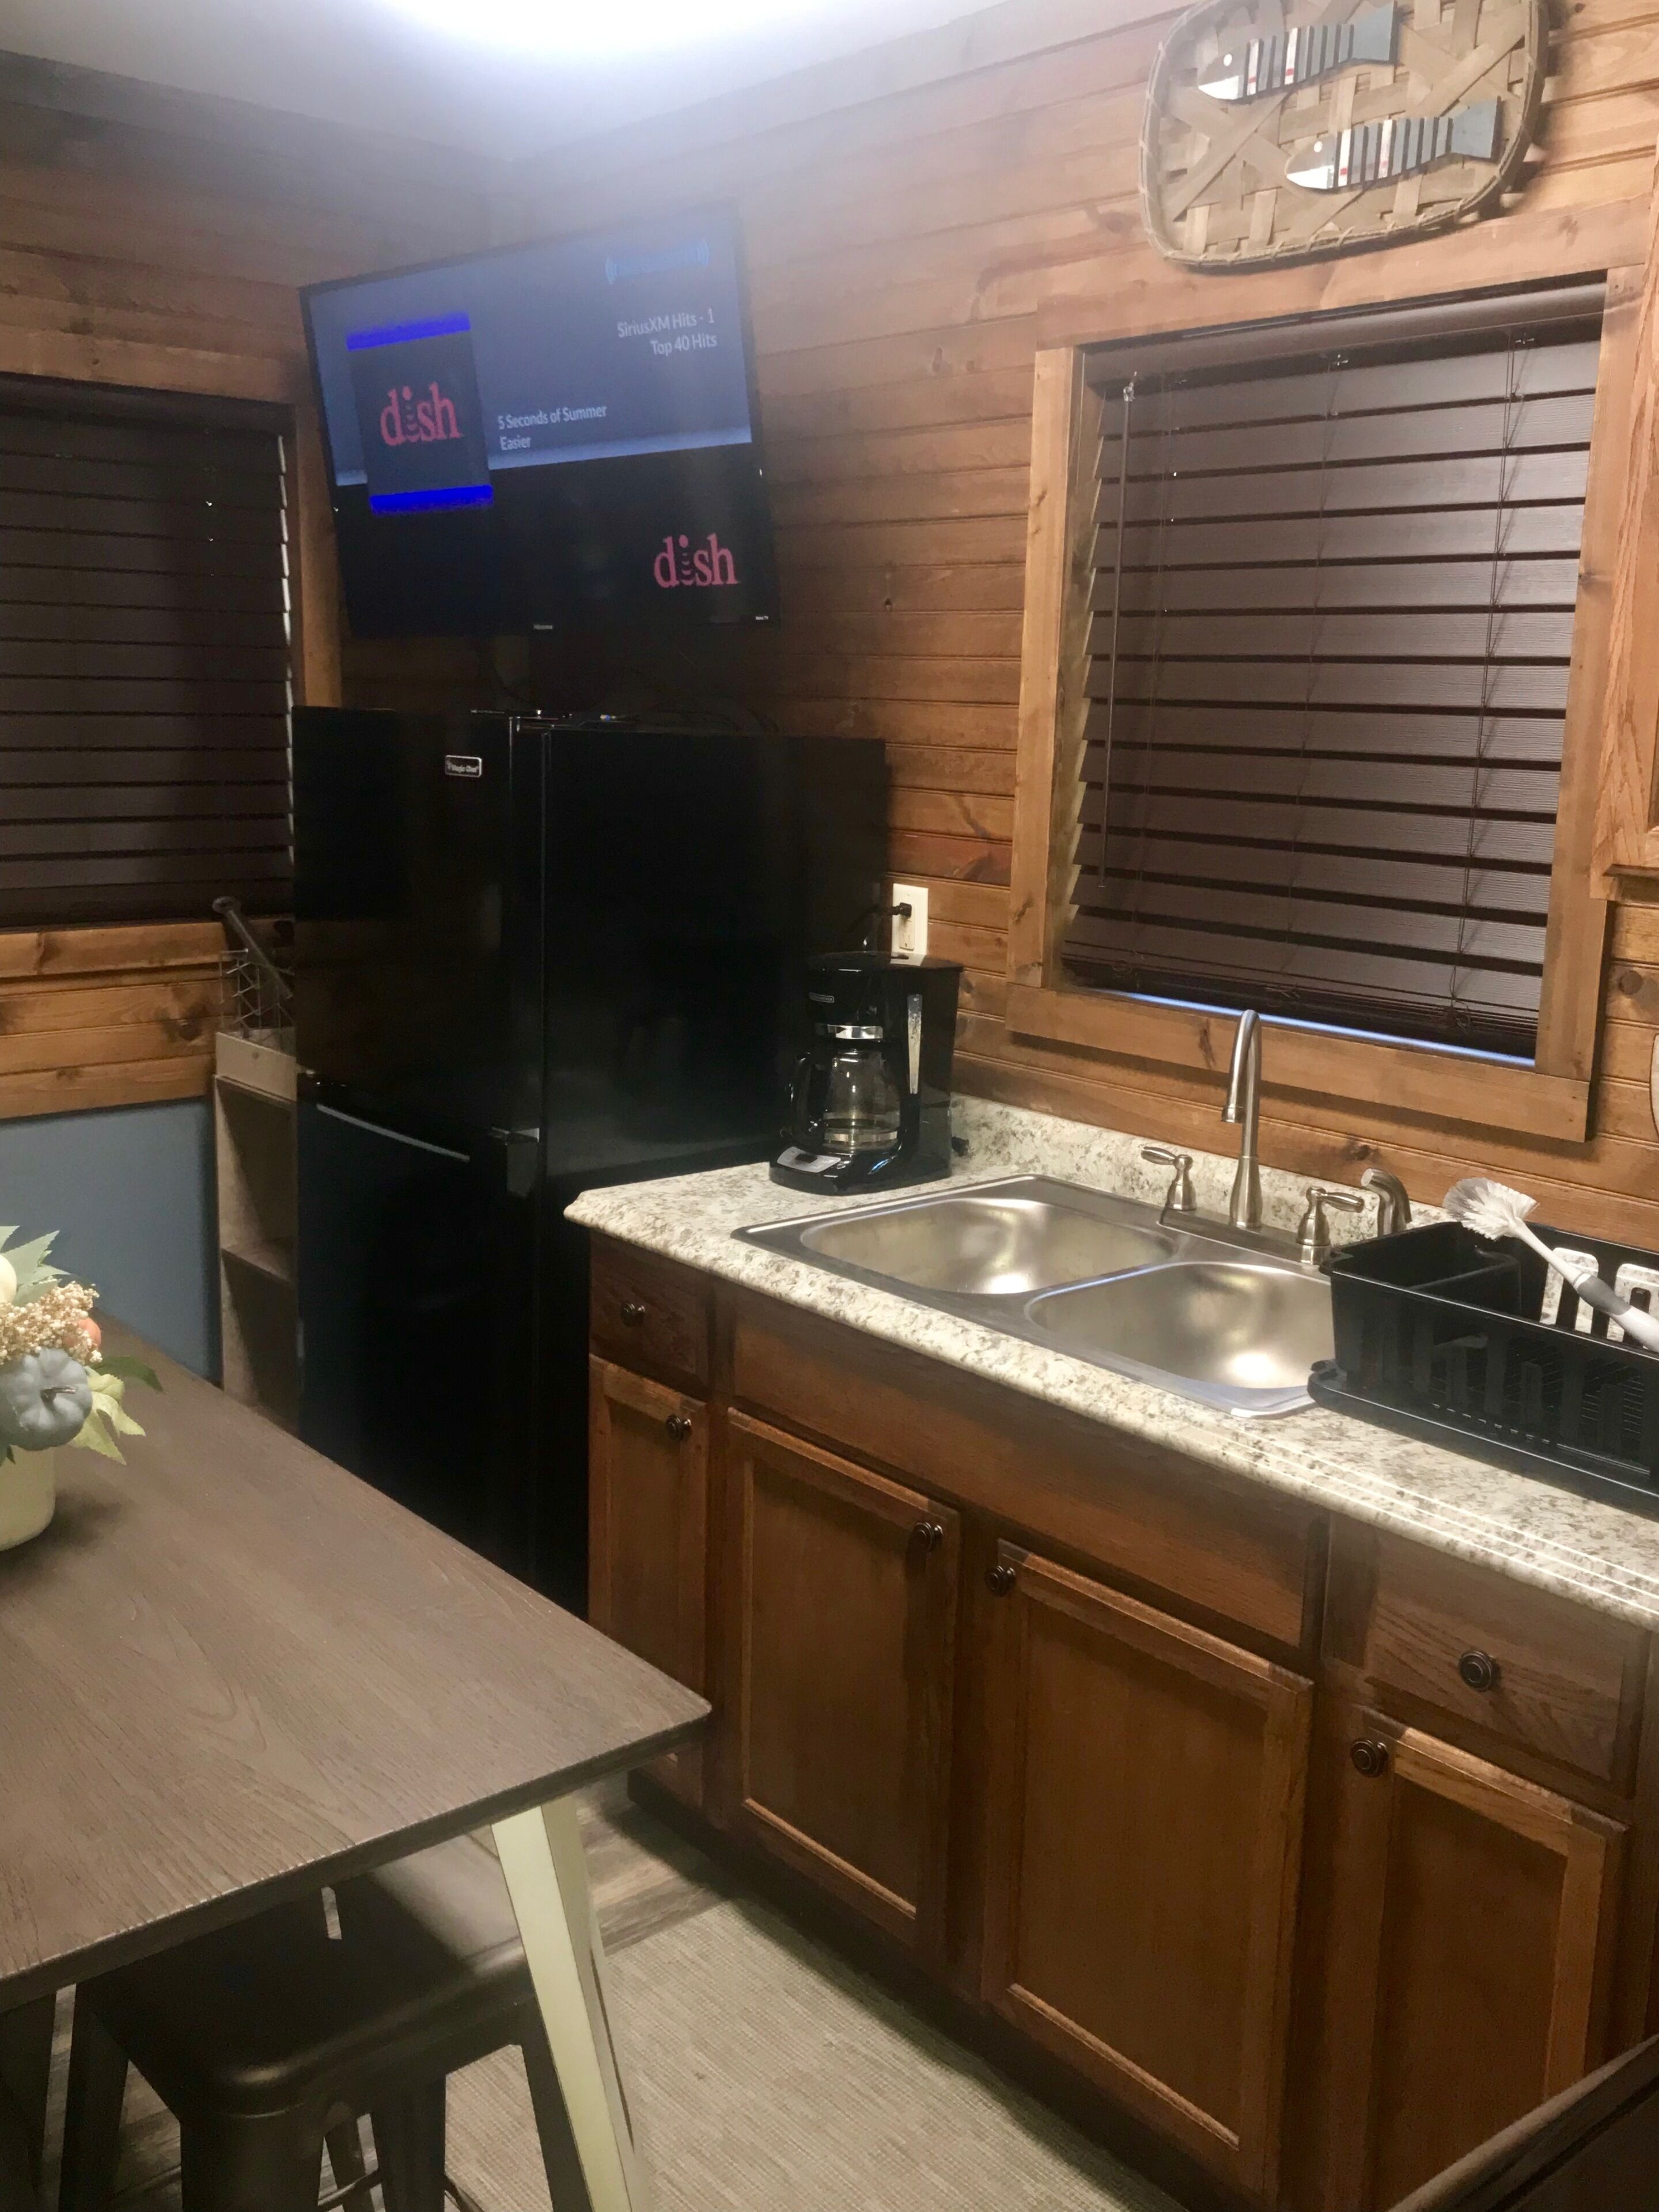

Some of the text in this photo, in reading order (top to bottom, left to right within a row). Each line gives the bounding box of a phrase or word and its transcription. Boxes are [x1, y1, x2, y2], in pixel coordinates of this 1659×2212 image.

[617, 316, 670, 338] SiriusXM
[672, 312, 697, 329] Hits
[707, 308, 714, 324] 1
[649, 333, 718, 357] Top 40 Hits
[380, 381, 463, 446] dish
[498, 406, 607, 430] 5 Seconds of Summer
[499, 435, 531, 450] Easier
[654, 532, 738, 588] dish
